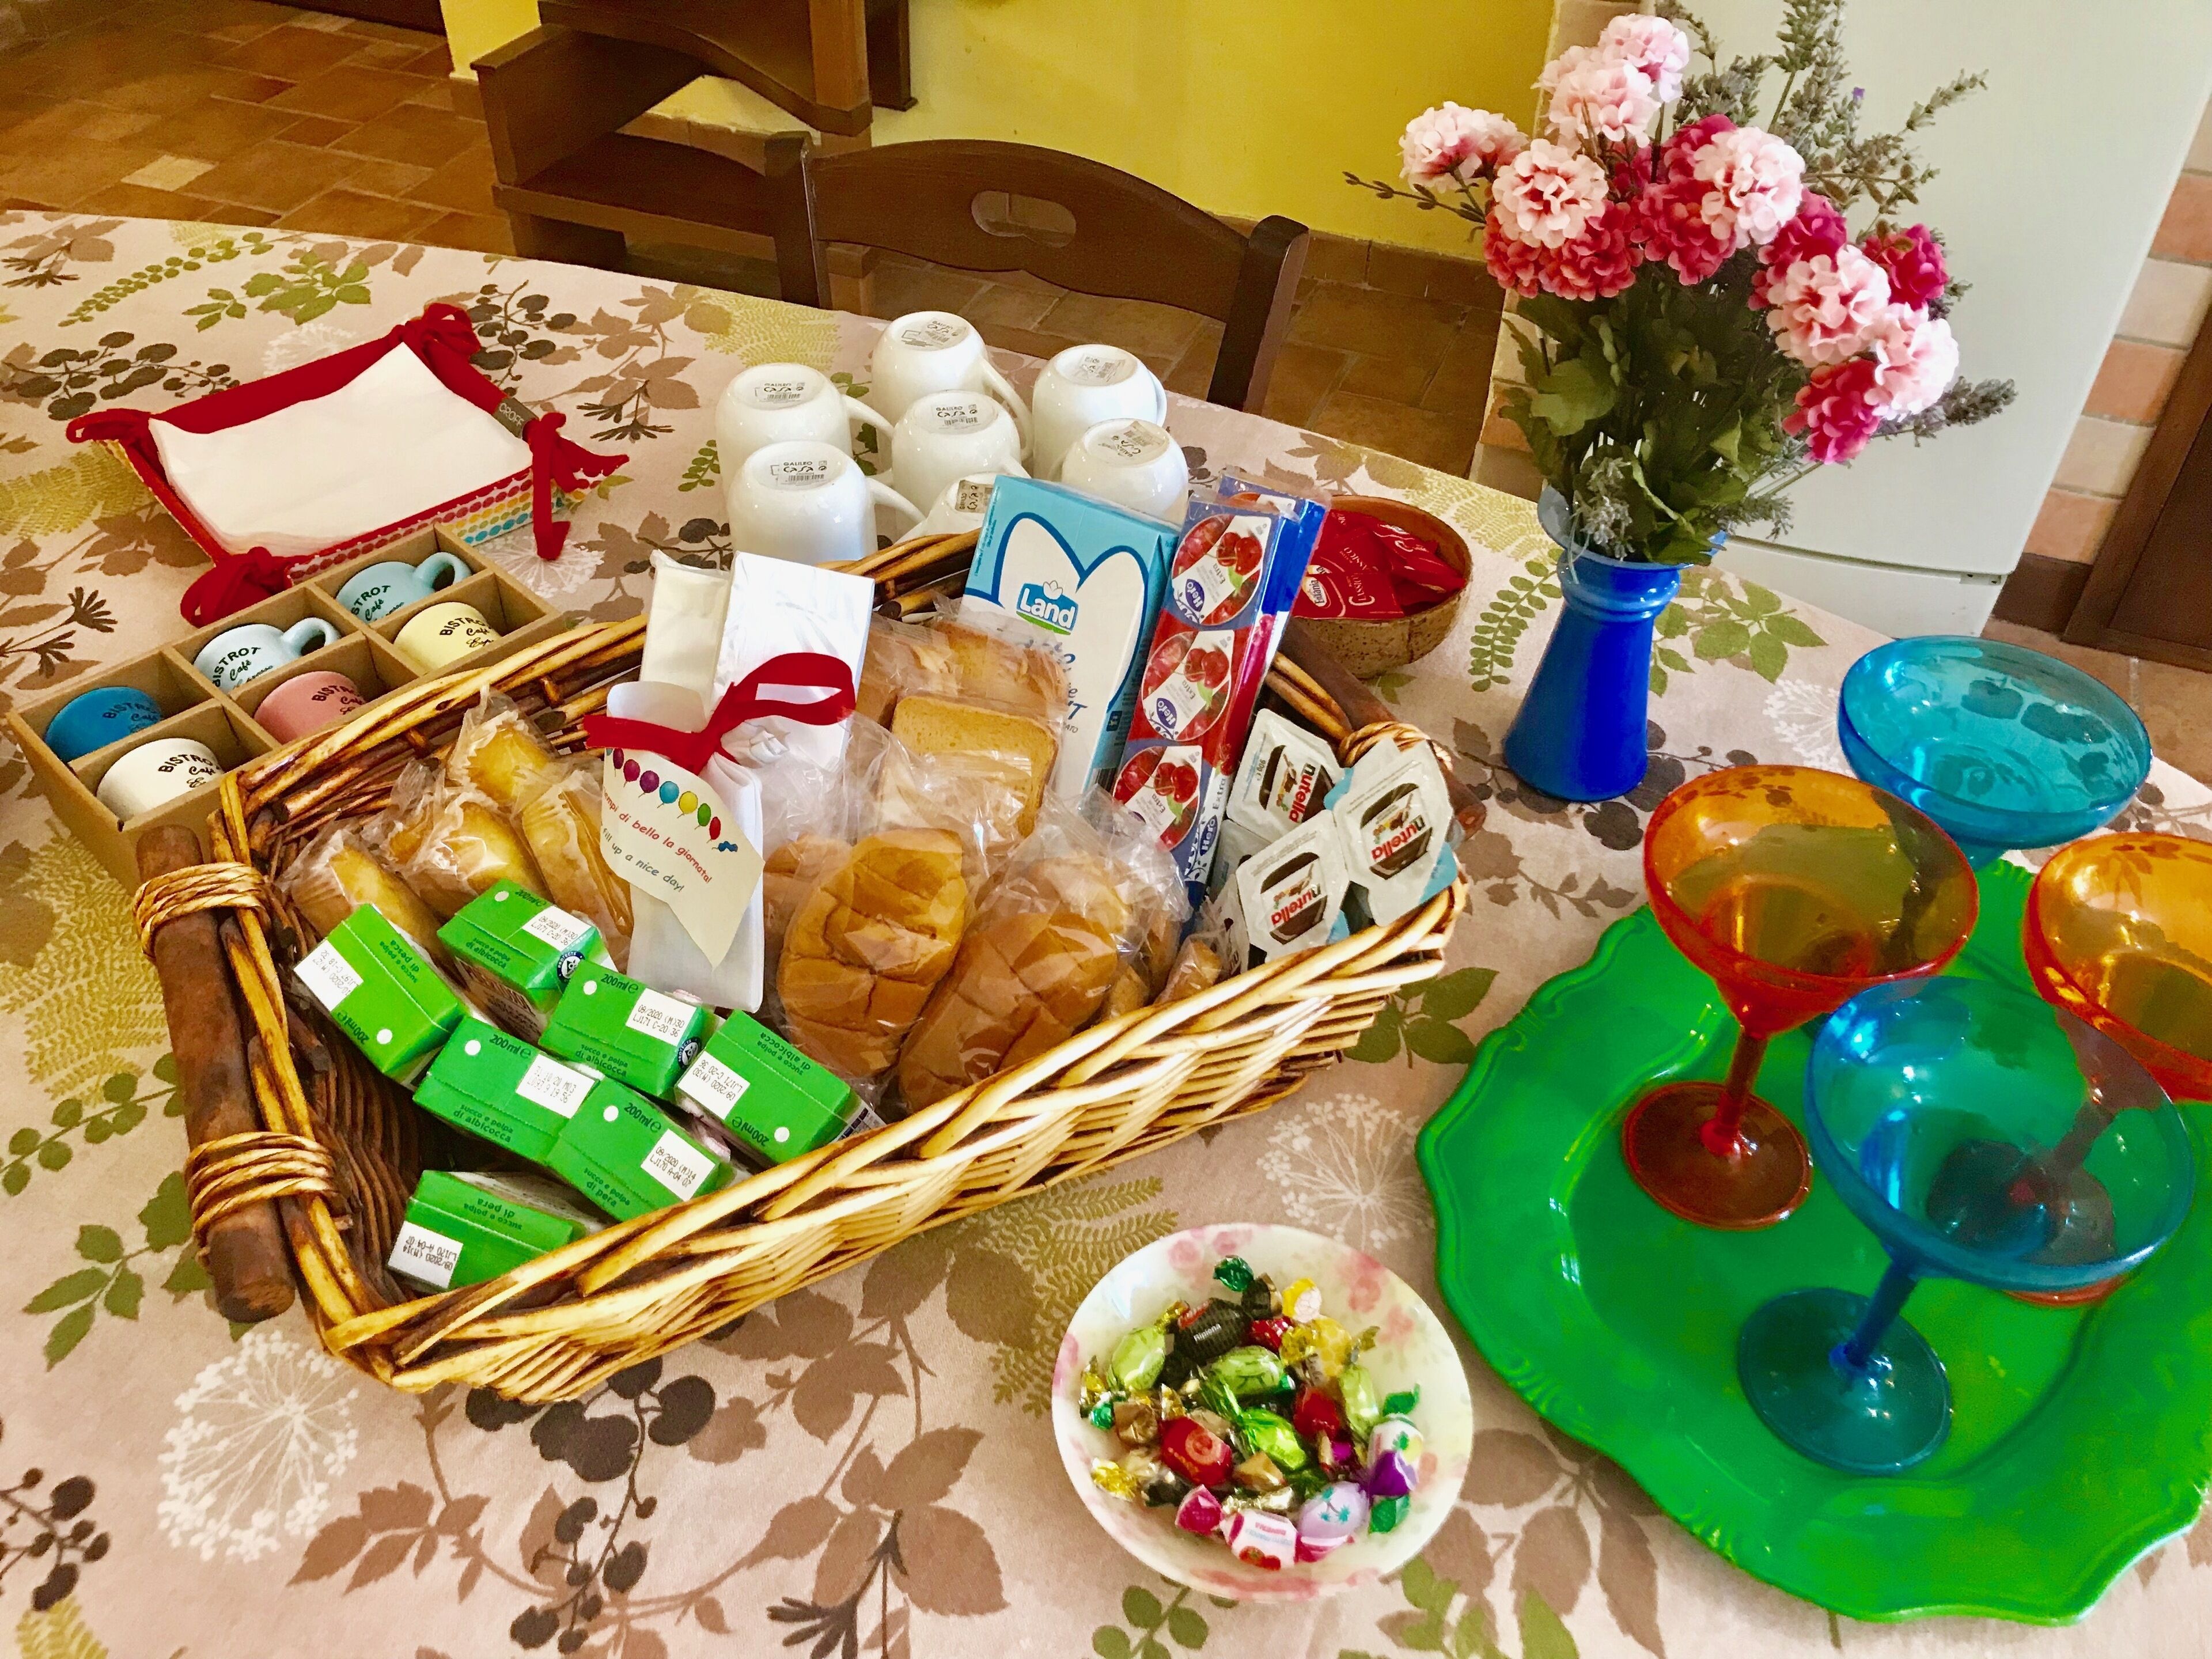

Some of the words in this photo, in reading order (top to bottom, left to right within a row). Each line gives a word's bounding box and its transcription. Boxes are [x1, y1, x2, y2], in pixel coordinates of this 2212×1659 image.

[499, 403, 525, 427] CROFF
[1213, 562, 1226, 585] Extra
[351, 585, 391, 615] STROT
[1186, 581, 1205, 608] Hero
[1019, 587, 1077, 629] Land
[439, 617, 491, 635] BISTRO
[1157, 700, 1176, 725] Hero
[158, 754, 221, 772] BISTRO
[1152, 793, 1166, 813] Extra
[1288, 762, 1316, 824] nutella
[619, 813, 631, 823] di
[632, 819, 661, 840] bello
[662, 836, 675, 849] la
[1201, 818, 1216, 851] Hero
[1370, 814, 1426, 860] nutella
[612, 843, 623, 855] up
[624, 853, 633, 861] a
[635, 858, 660, 876] nice
[662, 871, 685, 893] day!
[1270, 883, 1321, 926] nutella
[601, 973, 628, 991] 200ml
[631, 1012, 652, 1027] LJ171
[651, 1020, 669, 1033] C-20
[669, 1027, 680, 1037] 36
[489, 1033, 520, 1054] 200ml
[760, 1032, 801, 1064] albicocca
[586, 1054, 627, 1077] albicocca
[698, 1058, 710, 1069] 36
[707, 1065, 725, 1080] C-20
[723, 1075, 743, 1093] LJ171
[460, 1104, 483, 1119] succo
[491, 1118, 514, 1134] polpa
[624, 1102, 653, 1127] 200ml
[465, 1114, 512, 1143] albicocca
[743, 1124, 770, 1147] 200ml
[595, 1188, 617, 1207] pera
